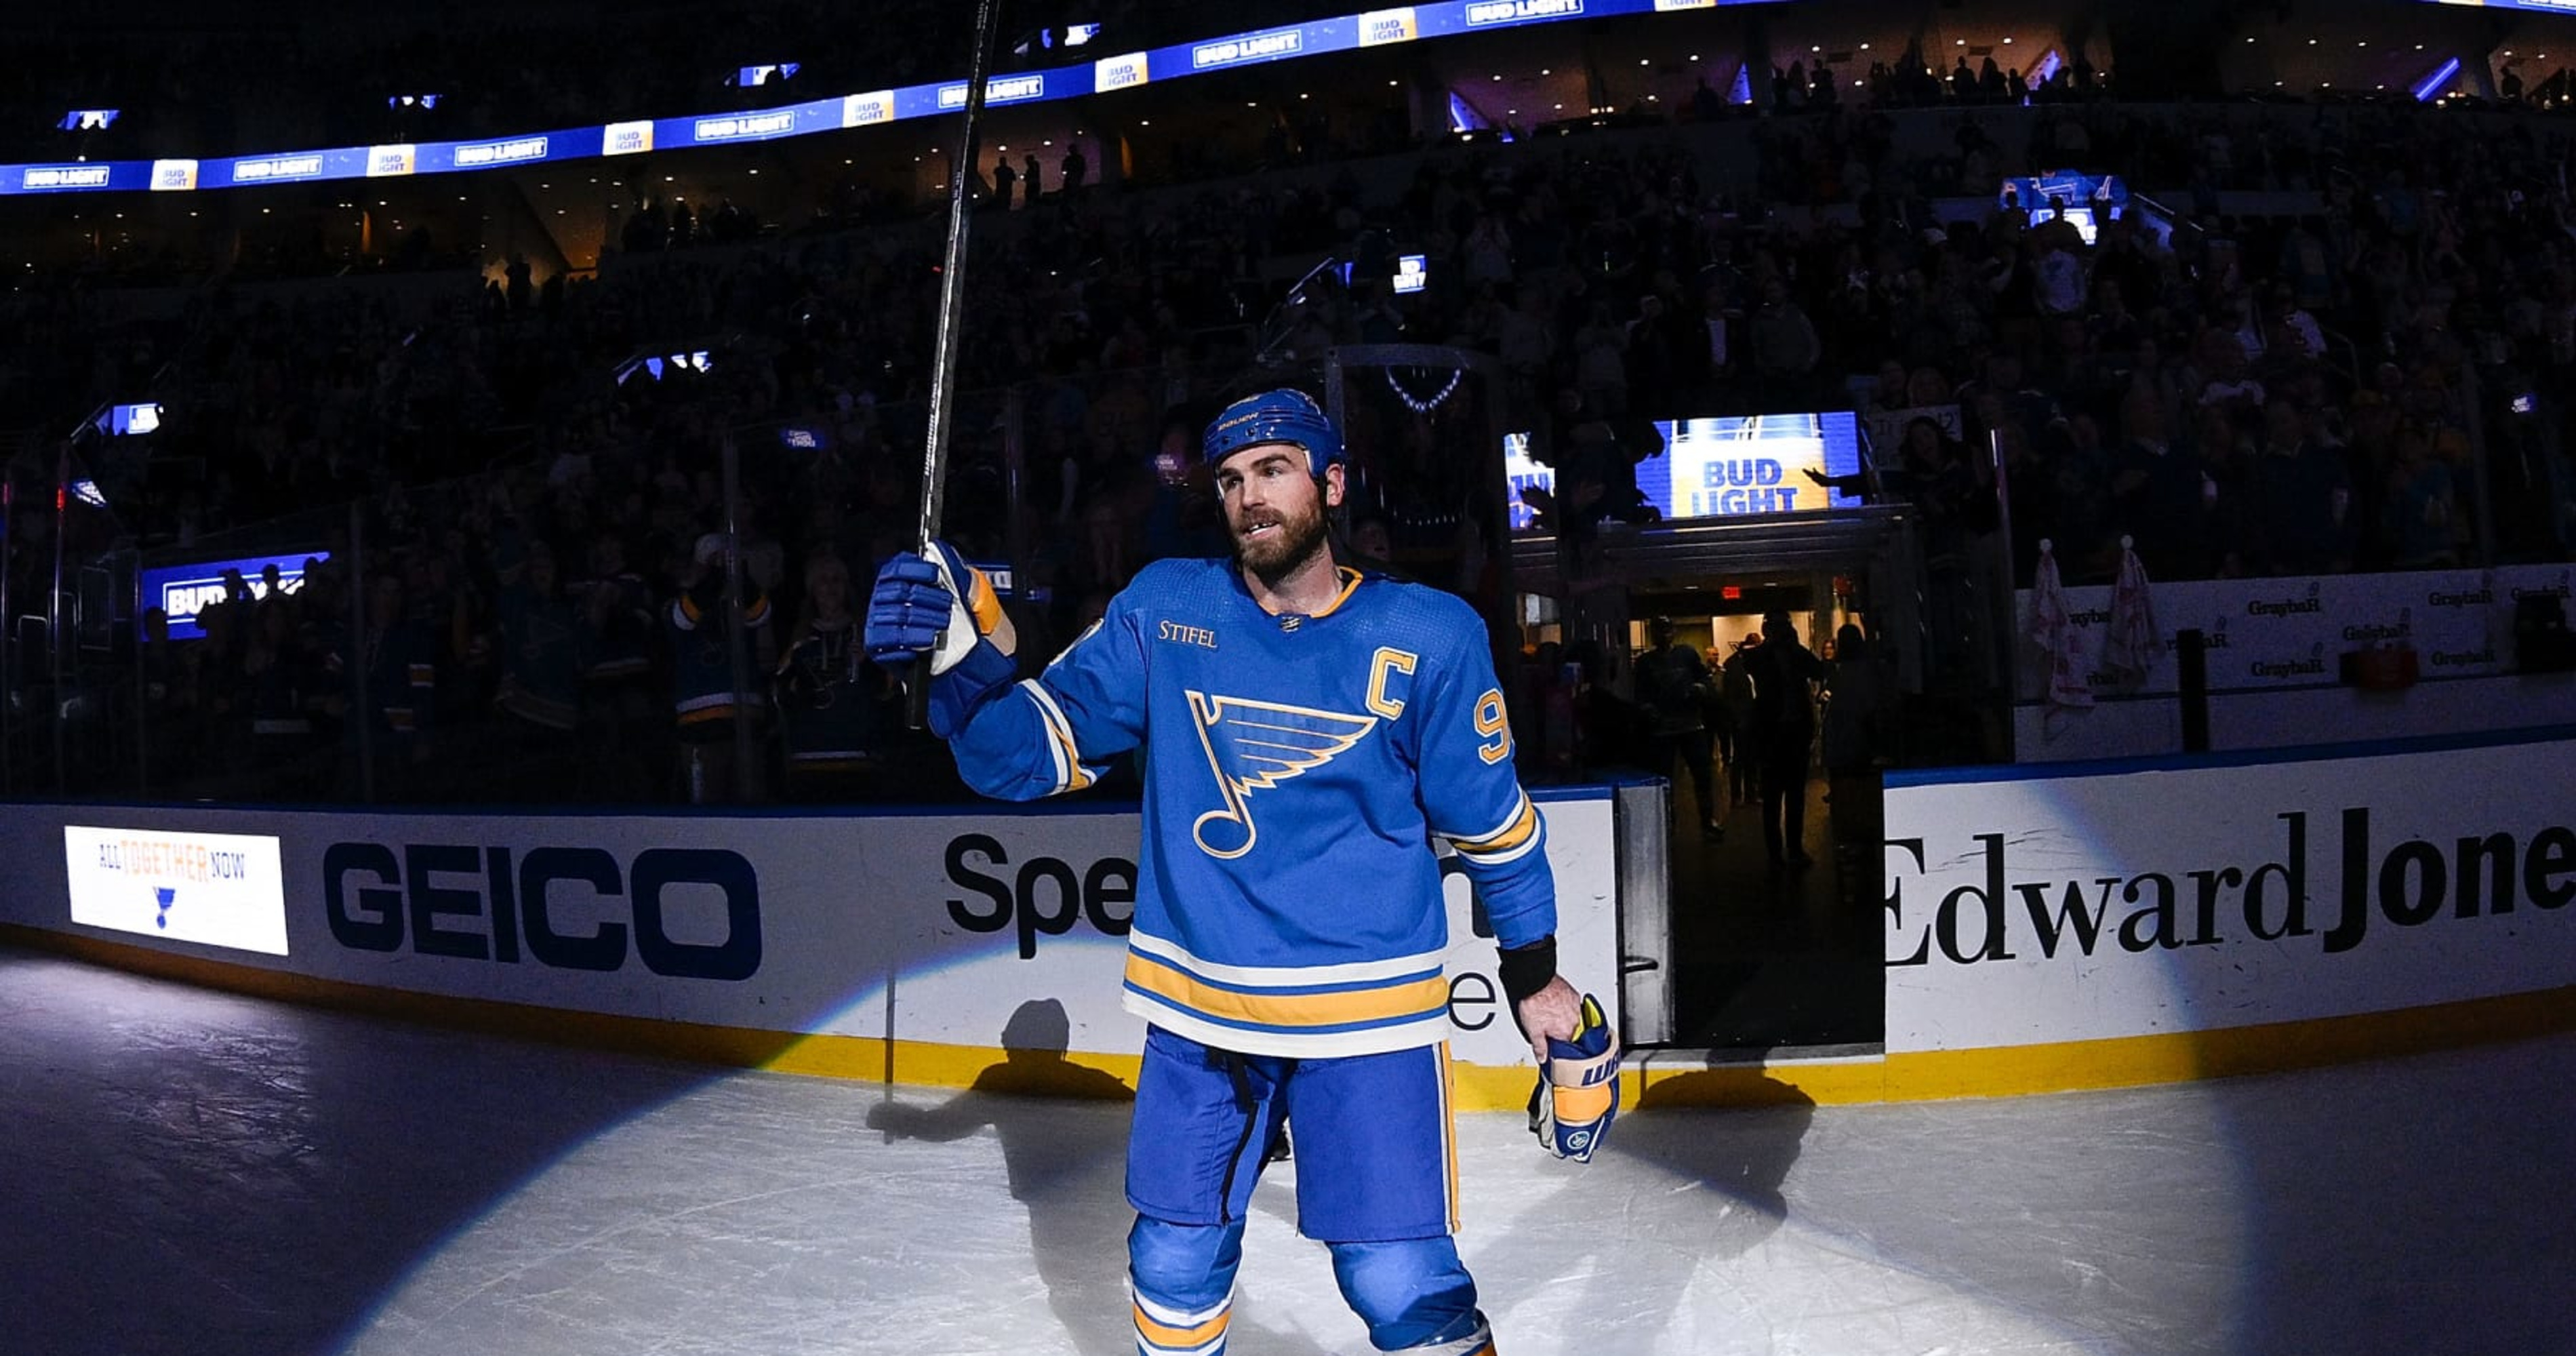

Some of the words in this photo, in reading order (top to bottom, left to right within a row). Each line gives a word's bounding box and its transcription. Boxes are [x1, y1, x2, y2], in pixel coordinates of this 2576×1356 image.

[1703, 458, 1783, 488] BUD
[1691, 487, 1798, 516] LIGHT
[1158, 620, 1218, 648] STIFEL
[1365, 646, 1419, 721] C
[99, 843, 121, 870] ALL
[121, 839, 209, 883] TOGETHER
[210, 851, 245, 880] NOW
[1883, 812, 2313, 966] Edward
[323, 842, 762, 981] GEICO
